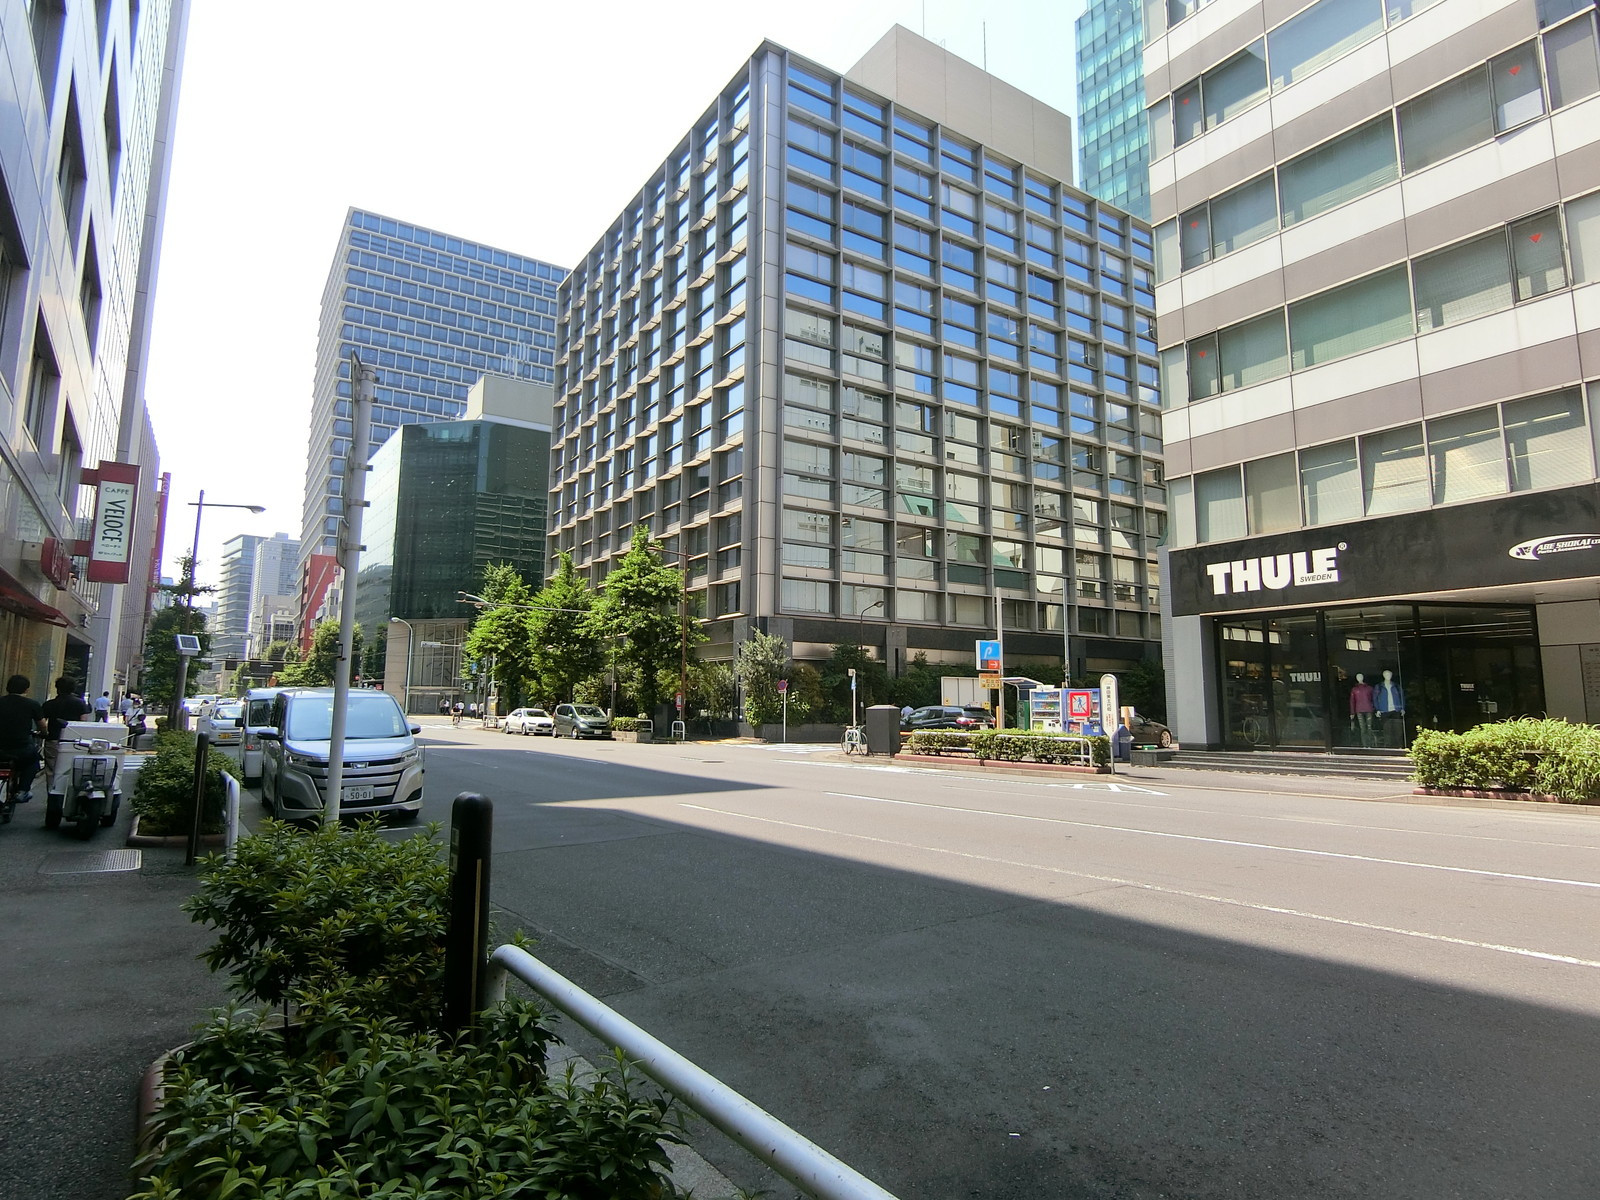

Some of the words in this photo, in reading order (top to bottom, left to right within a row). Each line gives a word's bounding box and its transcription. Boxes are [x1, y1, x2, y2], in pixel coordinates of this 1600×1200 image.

[102, 499, 126, 543] VELOCE
[1536, 543, 1556, 551] ABE
[1556, 538, 1592, 549] SHOKAI
[1206, 547, 1339, 596] THULE
[1299, 573, 1333, 583] SWEDEN
